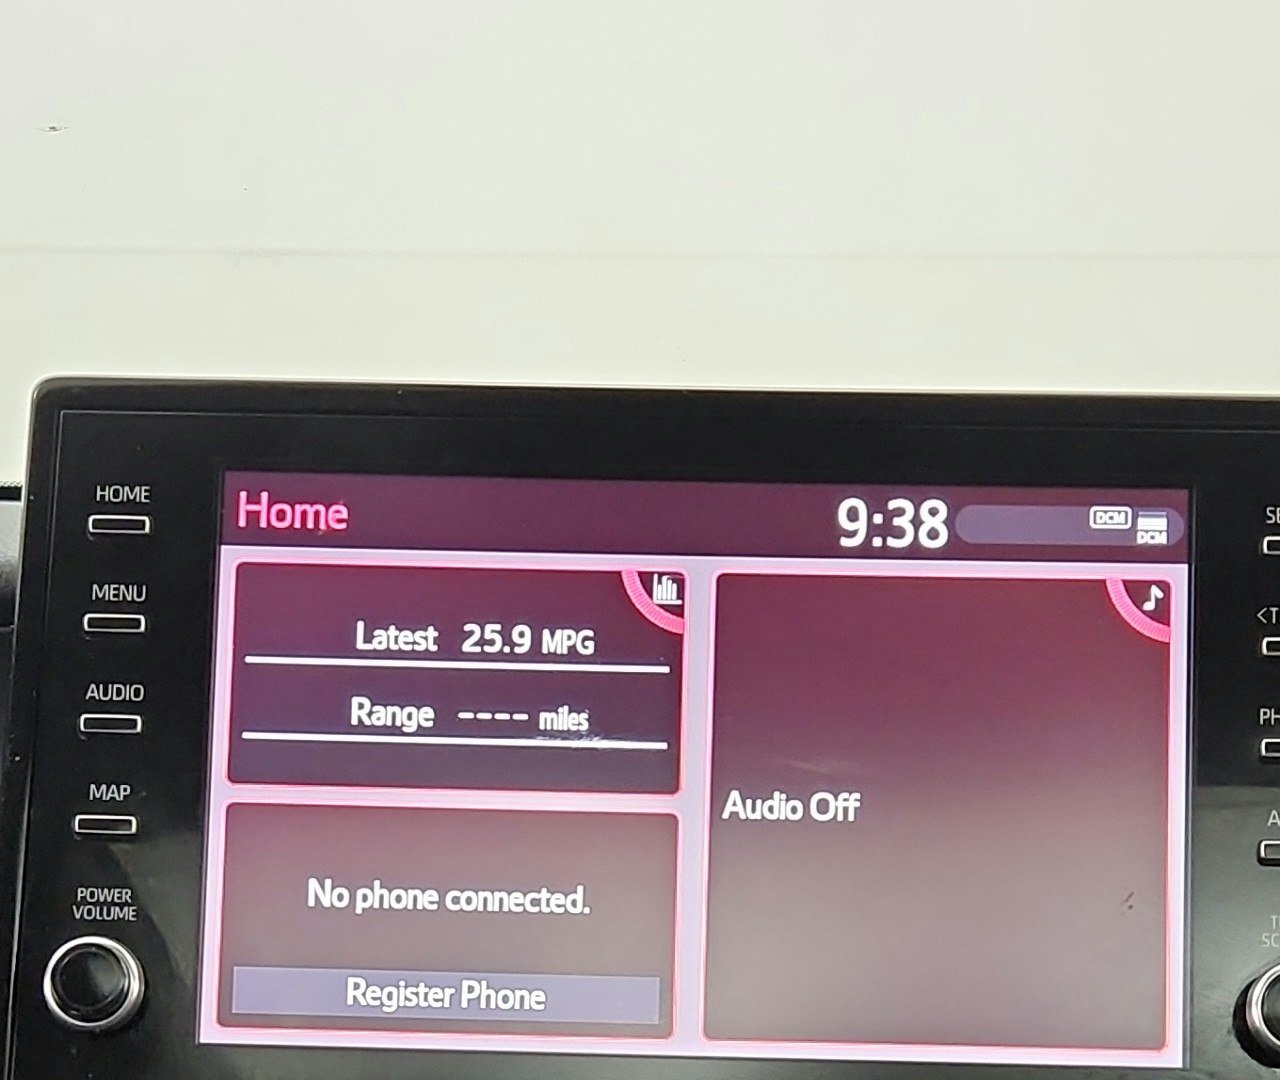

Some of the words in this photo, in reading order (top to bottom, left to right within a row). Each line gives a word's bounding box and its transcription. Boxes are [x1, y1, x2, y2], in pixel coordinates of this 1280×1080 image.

[96, 485, 151, 503] HOME
[237, 490, 349, 531] Home
[1095, 510, 1126, 525] DCM
[837, 497, 949, 549] 9:38
[1136, 531, 1168, 545] DCM
[91, 583, 147, 602] MENU
[355, 620, 439, 652] Latest
[461, 623, 532, 654] 25.9
[541, 628, 595, 656] MPG
[85, 683, 145, 702] AUDIO
[350, 696, 435, 733] Range
[537, 706, 590, 733] miles
[89, 783, 131, 801] MAP
[721, 789, 804, 821] Audio
[809, 791, 861, 822] Off
[77, 887, 132, 904] POWER
[307, 877, 350, 908] No
[355, 879, 440, 915] phone
[445, 884, 591, 914] connected.
[72, 904, 137, 921] VOLUME
[345, 976, 456, 1013] Register
[460, 979, 547, 1011] Phone
